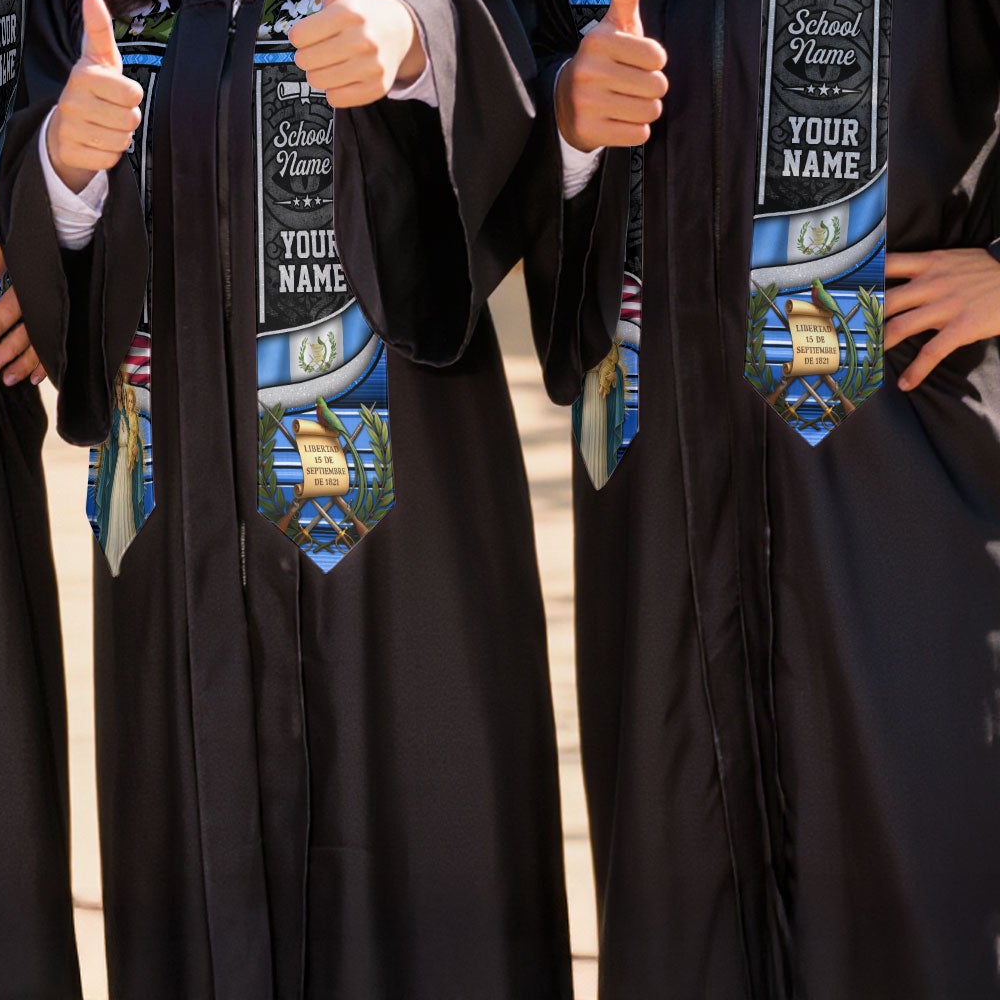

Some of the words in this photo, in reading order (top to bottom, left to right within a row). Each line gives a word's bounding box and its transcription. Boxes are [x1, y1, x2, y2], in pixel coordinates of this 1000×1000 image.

[788, 8, 863, 37] School
[789, 38, 857, 66] Name
[273, 119, 334, 148] School
[788, 116, 859, 147] YOUR
[276, 150, 333, 178] Name
[782, 149, 861, 180] NAME
[278, 264, 348, 293] NAME
[795, 324, 832, 333] LIBERTAD
[805, 335, 814, 344] 15
[815, 335, 826, 344] DE
[796, 346, 837, 355] SEPTIEMBRE
[804, 357, 814, 365] DE
[815, 357, 829, 365] 1821
[303, 444, 340, 453] LIBERTAD
[314, 456, 323, 464] 15
[324, 456, 334, 464] DE
[306, 466, 346, 475] SEPTIEMBRE
[314, 478, 324, 486] DE
[325, 478, 339, 486] 1821
